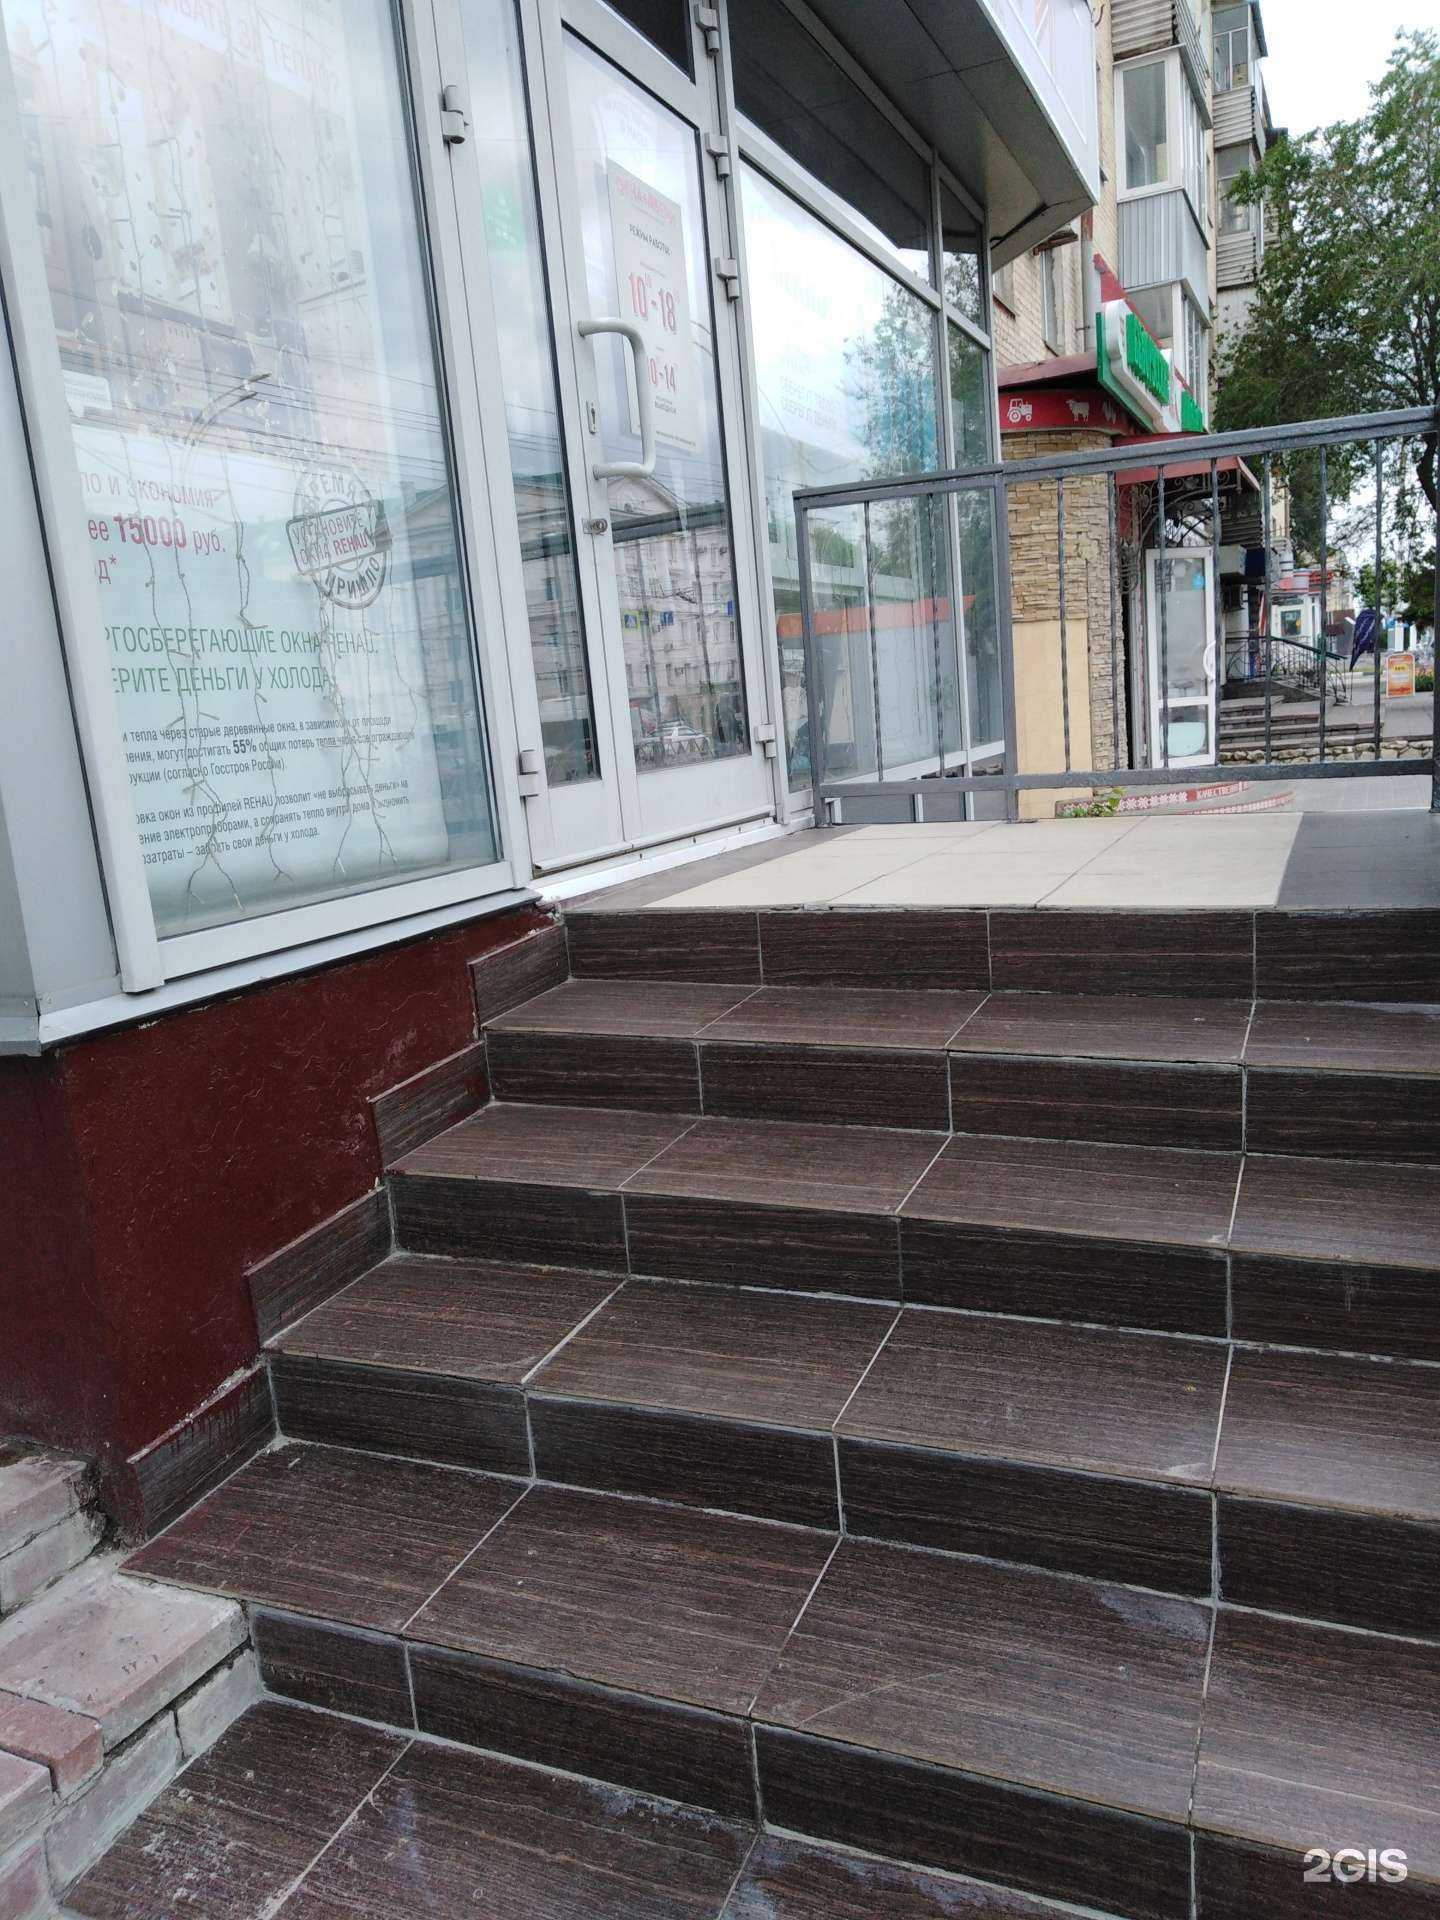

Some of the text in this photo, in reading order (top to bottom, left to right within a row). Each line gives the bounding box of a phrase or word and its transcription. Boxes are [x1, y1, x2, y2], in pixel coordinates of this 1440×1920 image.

[113, 514, 187, 548] 15000
[193, 528, 226, 556] руб.
[333, 532, 368, 556] REHAU
[281, 630, 322, 653] ОКНА
[177, 666, 249, 697] ДЕНЬГИ
[253, 666, 263, 689] У
[268, 664, 331, 692] ХОЛОДА
[130, 730, 158, 743] тепла
[160, 727, 187, 741] через
[189, 724, 221, 738] старые
[224, 721, 275, 738] деревянные
[157, 747, 184, 761] могут
[187, 745, 231, 760] достигать
[232, 738, 257, 754] 55%
[259, 740, 286, 753] общих
[288, 738, 315, 751] потерь
[163, 764, 209, 783] (согласно
[211, 761, 249, 777] Госстроя
[158, 808, 181, 821] окон
[184, 806, 195, 818] из
[197, 799, 242, 819] профилей
[244, 796, 273, 811] REHAU
[276, 792, 311, 806] позволит
[164, 818, 253, 841] электроприборами,
[260, 811, 302, 827] сохранять
[302, 806, 325, 820] тепло
[255, 832, 283, 849] деньги
